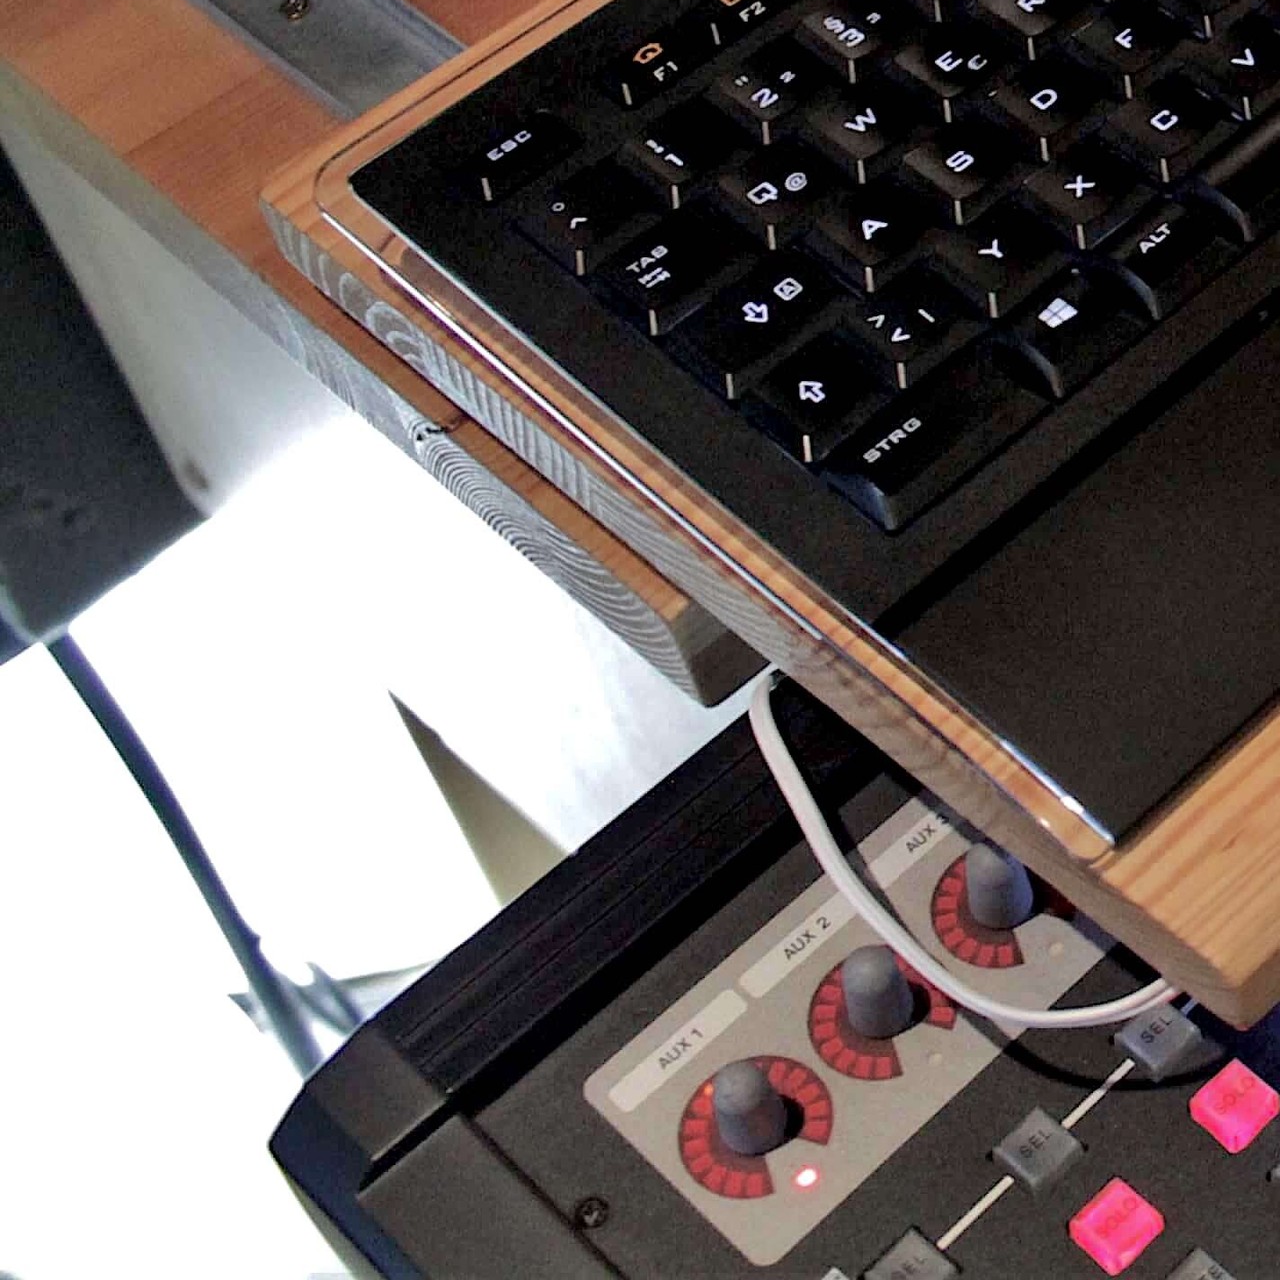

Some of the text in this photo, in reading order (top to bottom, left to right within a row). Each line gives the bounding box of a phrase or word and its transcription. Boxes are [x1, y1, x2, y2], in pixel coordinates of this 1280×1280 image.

[739, 2, 765, 22] F2
[839, 29, 864, 47] 3
[1115, 29, 1131, 48] F
[935, 51, 962, 71] E
[1231, 49, 1254, 65] V
[654, 62, 677, 81] F1
[752, 89, 778, 108] 2
[1030, 89, 1057, 109] D
[845, 108, 876, 131] W
[1151, 110, 1178, 130] C
[487, 131, 531, 160] ESC
[946, 151, 973, 172] S
[785, 173, 807, 191] @
[1064, 176, 1095, 197] X
[747, 182, 777, 204] Q
[862, 220, 887, 240] A
[1140, 223, 1170, 253] ALT
[626, 245, 668, 273] TAB
[978, 239, 1003, 258] Y
[863, 418, 921, 462] STRG
[905, 823, 936, 853] AUX
[783, 915, 832, 960] AUX 2
[1140, 1015, 1175, 1044] SEL
[658, 1039, 693, 1070] AUX
[1217, 1074, 1256, 1115] SOLO
[1019, 1130, 1051, 1158] SEL
[1101, 1197, 1139, 1239] SOLO
